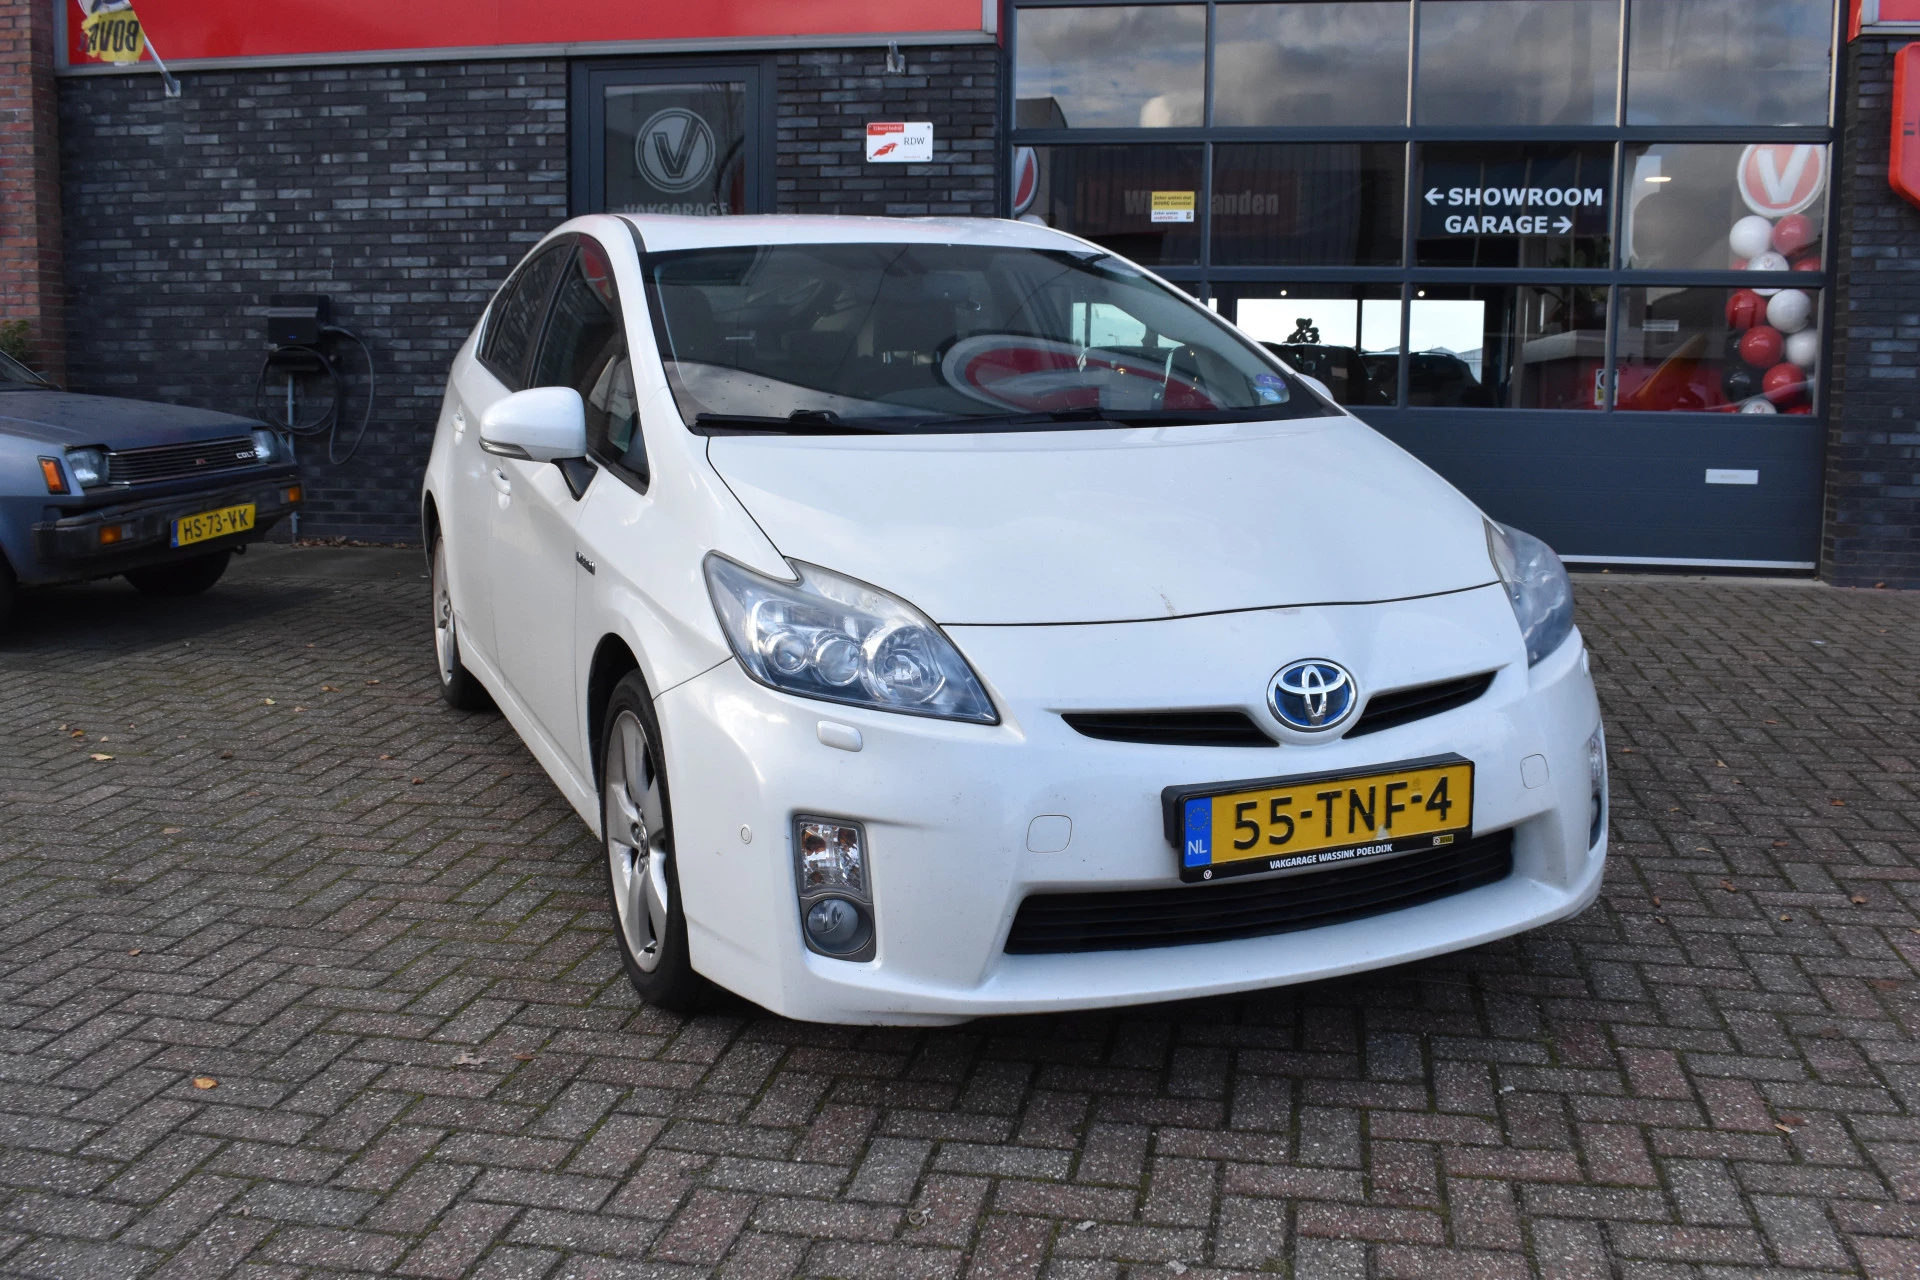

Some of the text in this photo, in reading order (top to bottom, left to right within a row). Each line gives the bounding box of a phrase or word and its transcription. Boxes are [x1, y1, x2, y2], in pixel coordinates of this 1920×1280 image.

[903, 136, 925, 146] RDW
[1448, 187, 1603, 207] SHOWROOM
[623, 203, 728, 216] VAKGARAGE
[1445, 216, 1549, 234] GARAGE
[236, 450, 255, 459] COLT
[183, 508, 249, 541] HS-73-VK
[1233, 775, 1453, 851] 55-TNF-4
[1187, 839, 1208, 856] NL
[1269, 843, 1393, 870] VAKGARAGE WASSINK POELDIJK
